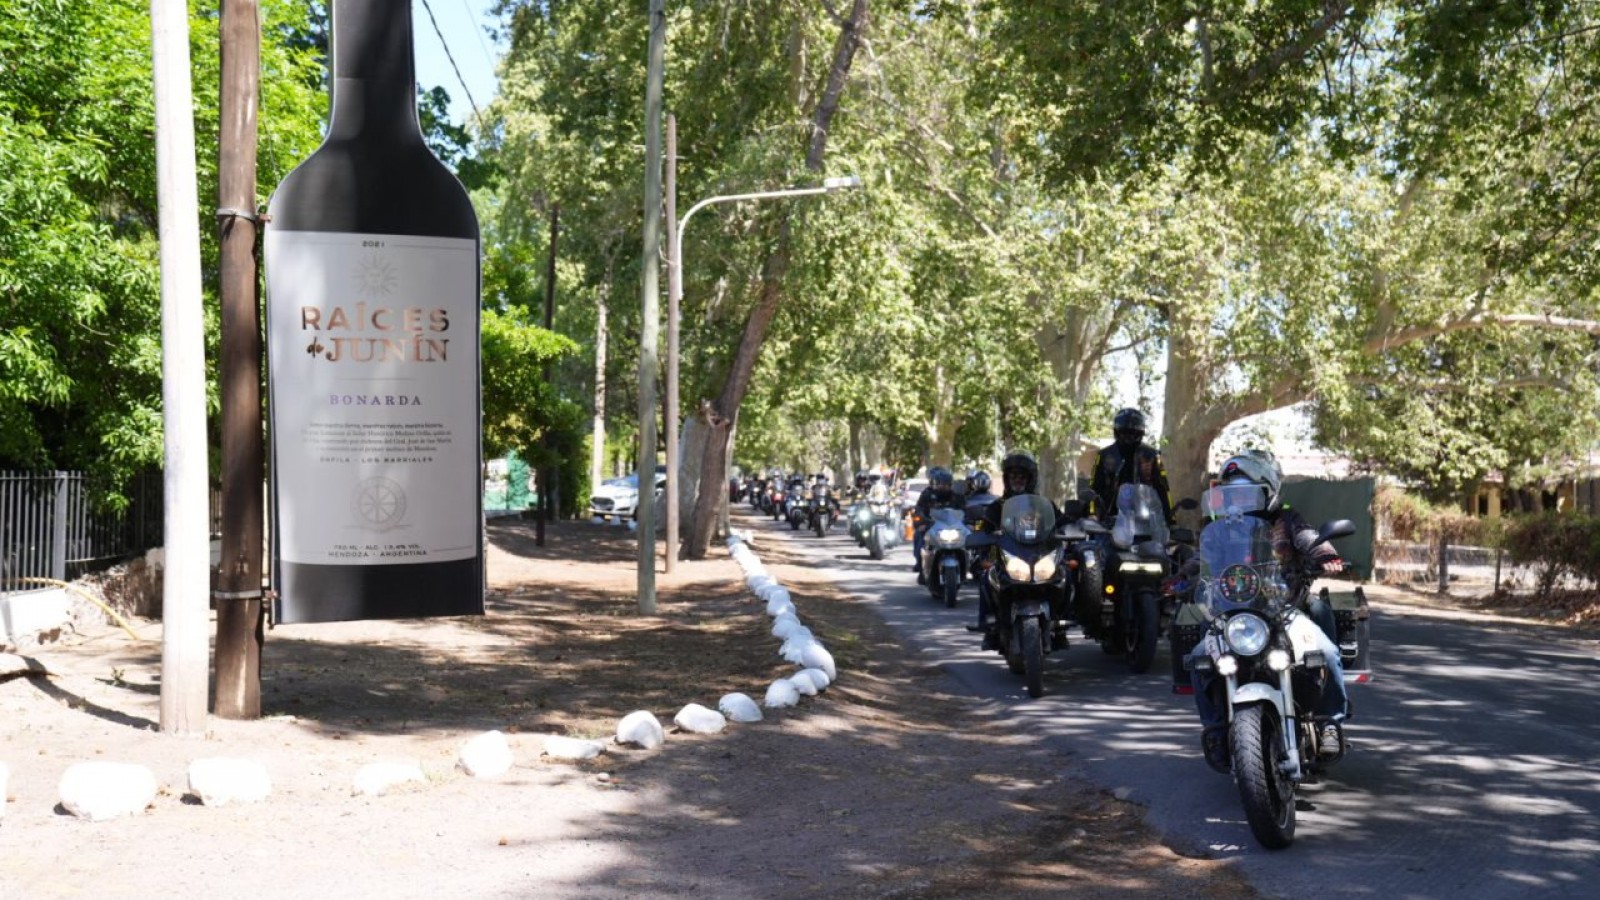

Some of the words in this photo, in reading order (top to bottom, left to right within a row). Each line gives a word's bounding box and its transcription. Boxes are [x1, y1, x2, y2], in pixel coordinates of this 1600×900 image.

[362, 240, 385, 248] 2021
[301, 301, 450, 332] RAÍCES
[306, 336, 324, 358] de
[325, 334, 450, 363] JUNÍN
[329, 394, 423, 406] BONARDA
[380, 549, 427, 557] ARGENTINA
